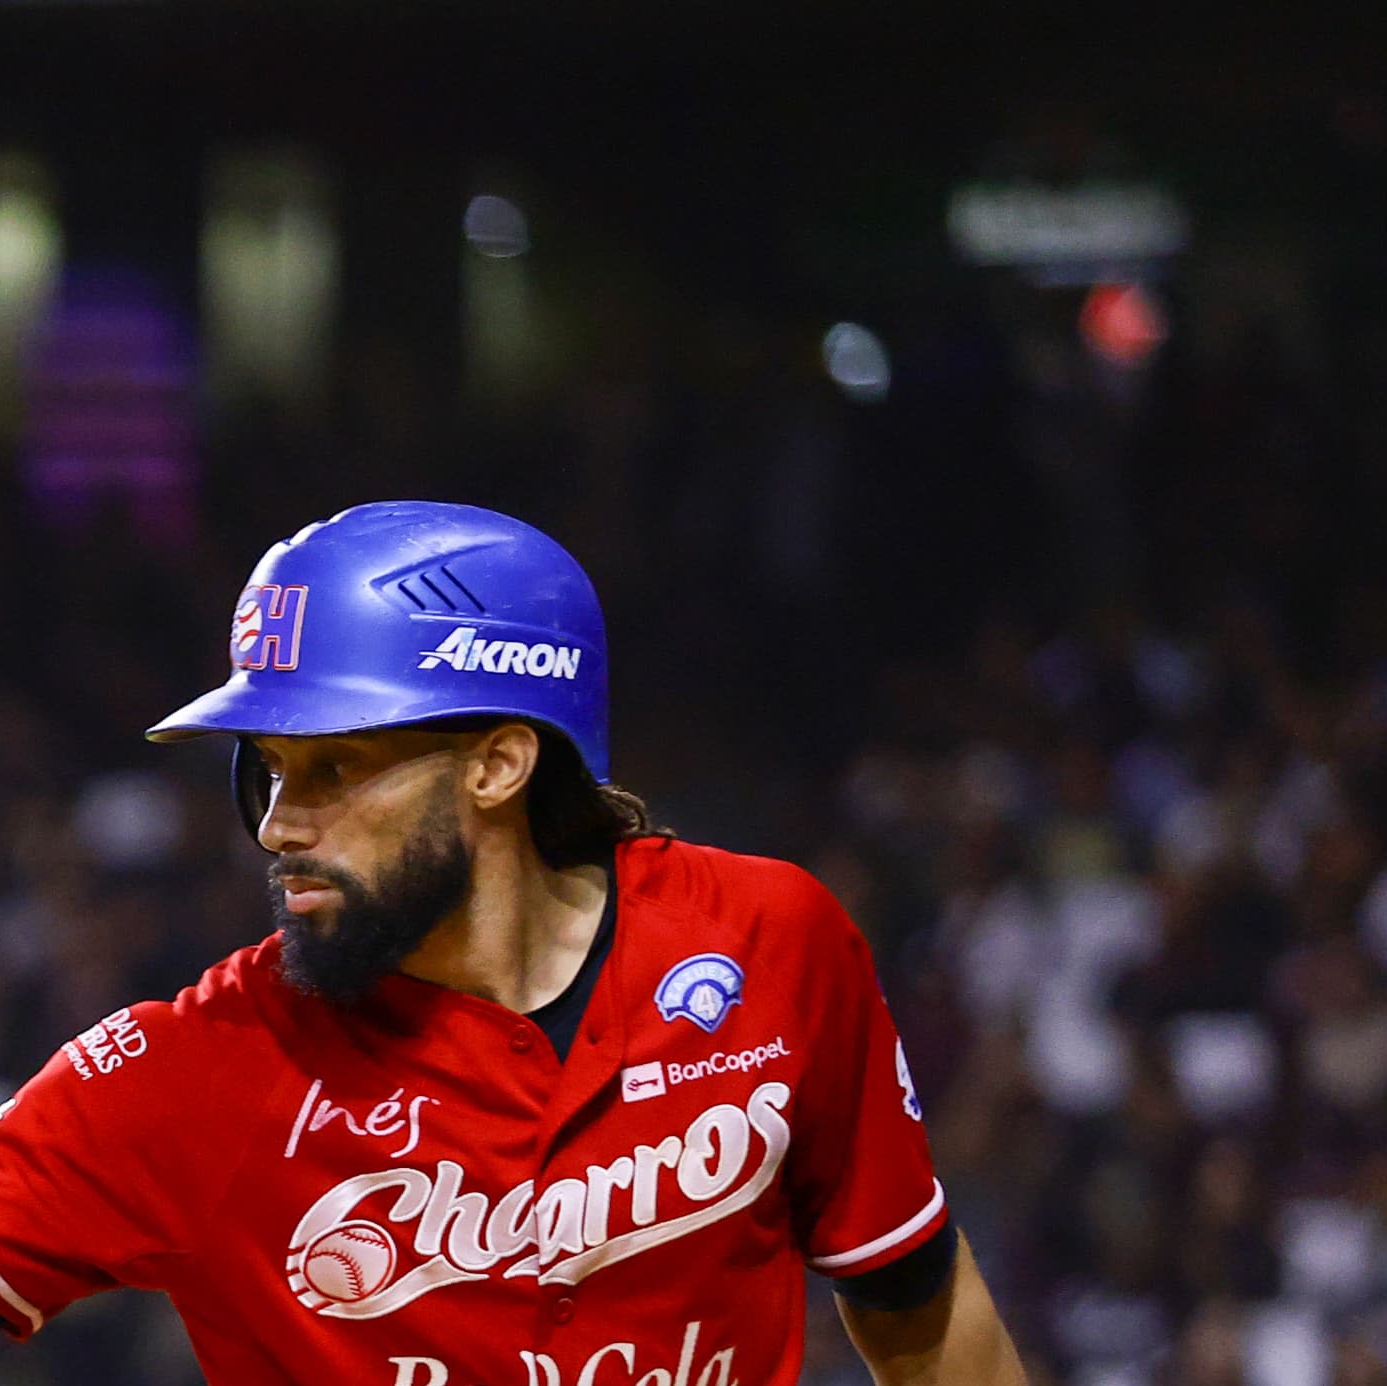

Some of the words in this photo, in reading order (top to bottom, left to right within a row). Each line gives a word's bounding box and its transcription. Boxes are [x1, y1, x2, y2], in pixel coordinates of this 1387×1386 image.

[417, 626, 582, 680] AKRON
[668, 1035, 790, 1086] BanCoppel
[284, 1078, 440, 1159] Inés
[285, 1081, 791, 1320] Charros
